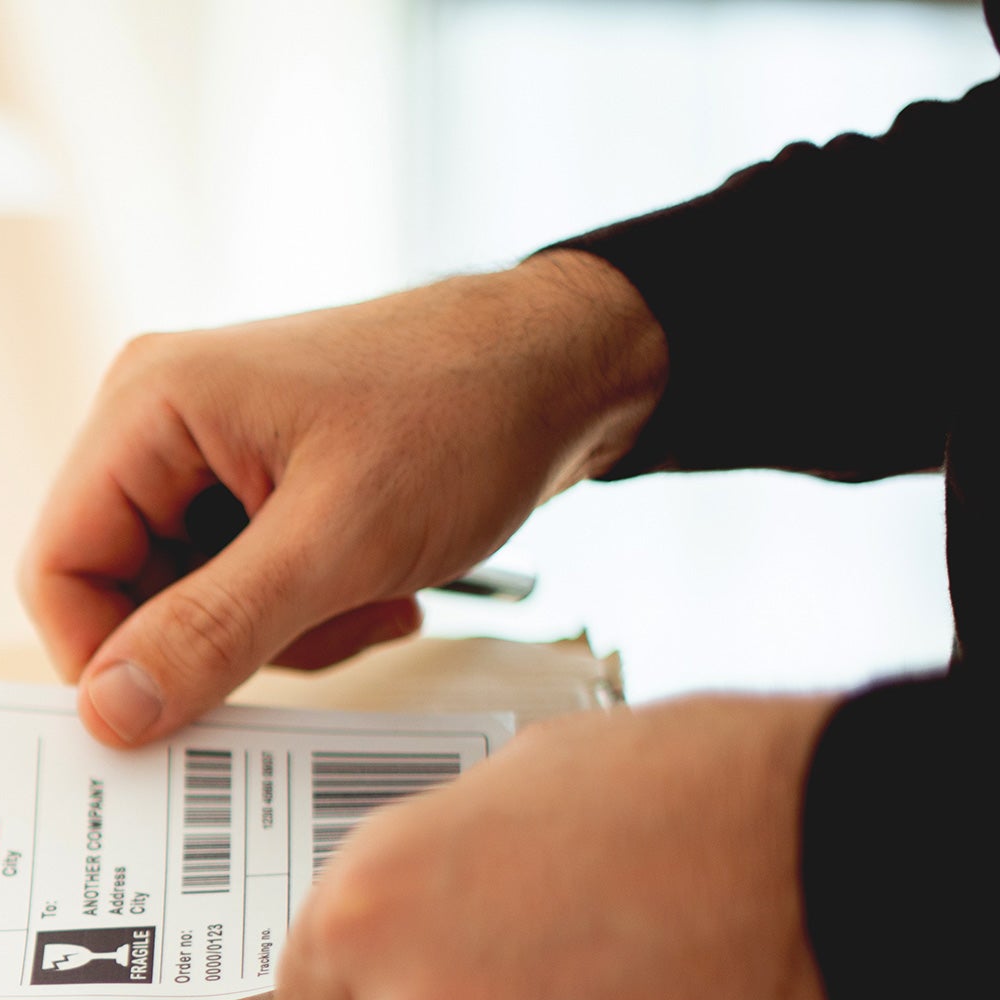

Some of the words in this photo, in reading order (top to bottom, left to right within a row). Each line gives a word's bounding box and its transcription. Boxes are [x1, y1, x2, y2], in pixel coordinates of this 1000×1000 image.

[87, 778, 104, 851] COMPANY
[2, 850, 22, 877] City
[83, 855, 101, 916] ANOTHER
[109, 866, 126, 915] Address
[130, 891, 150, 915] City
[41, 900, 58, 919] To:
[180, 930, 193, 947] no:
[261, 928, 271, 941] no.
[130, 929, 150, 980] FRAGILE
[174, 950, 192, 984] Order
[204, 923, 223, 982] 0000/0123
[257, 942, 273, 978] Tracking
